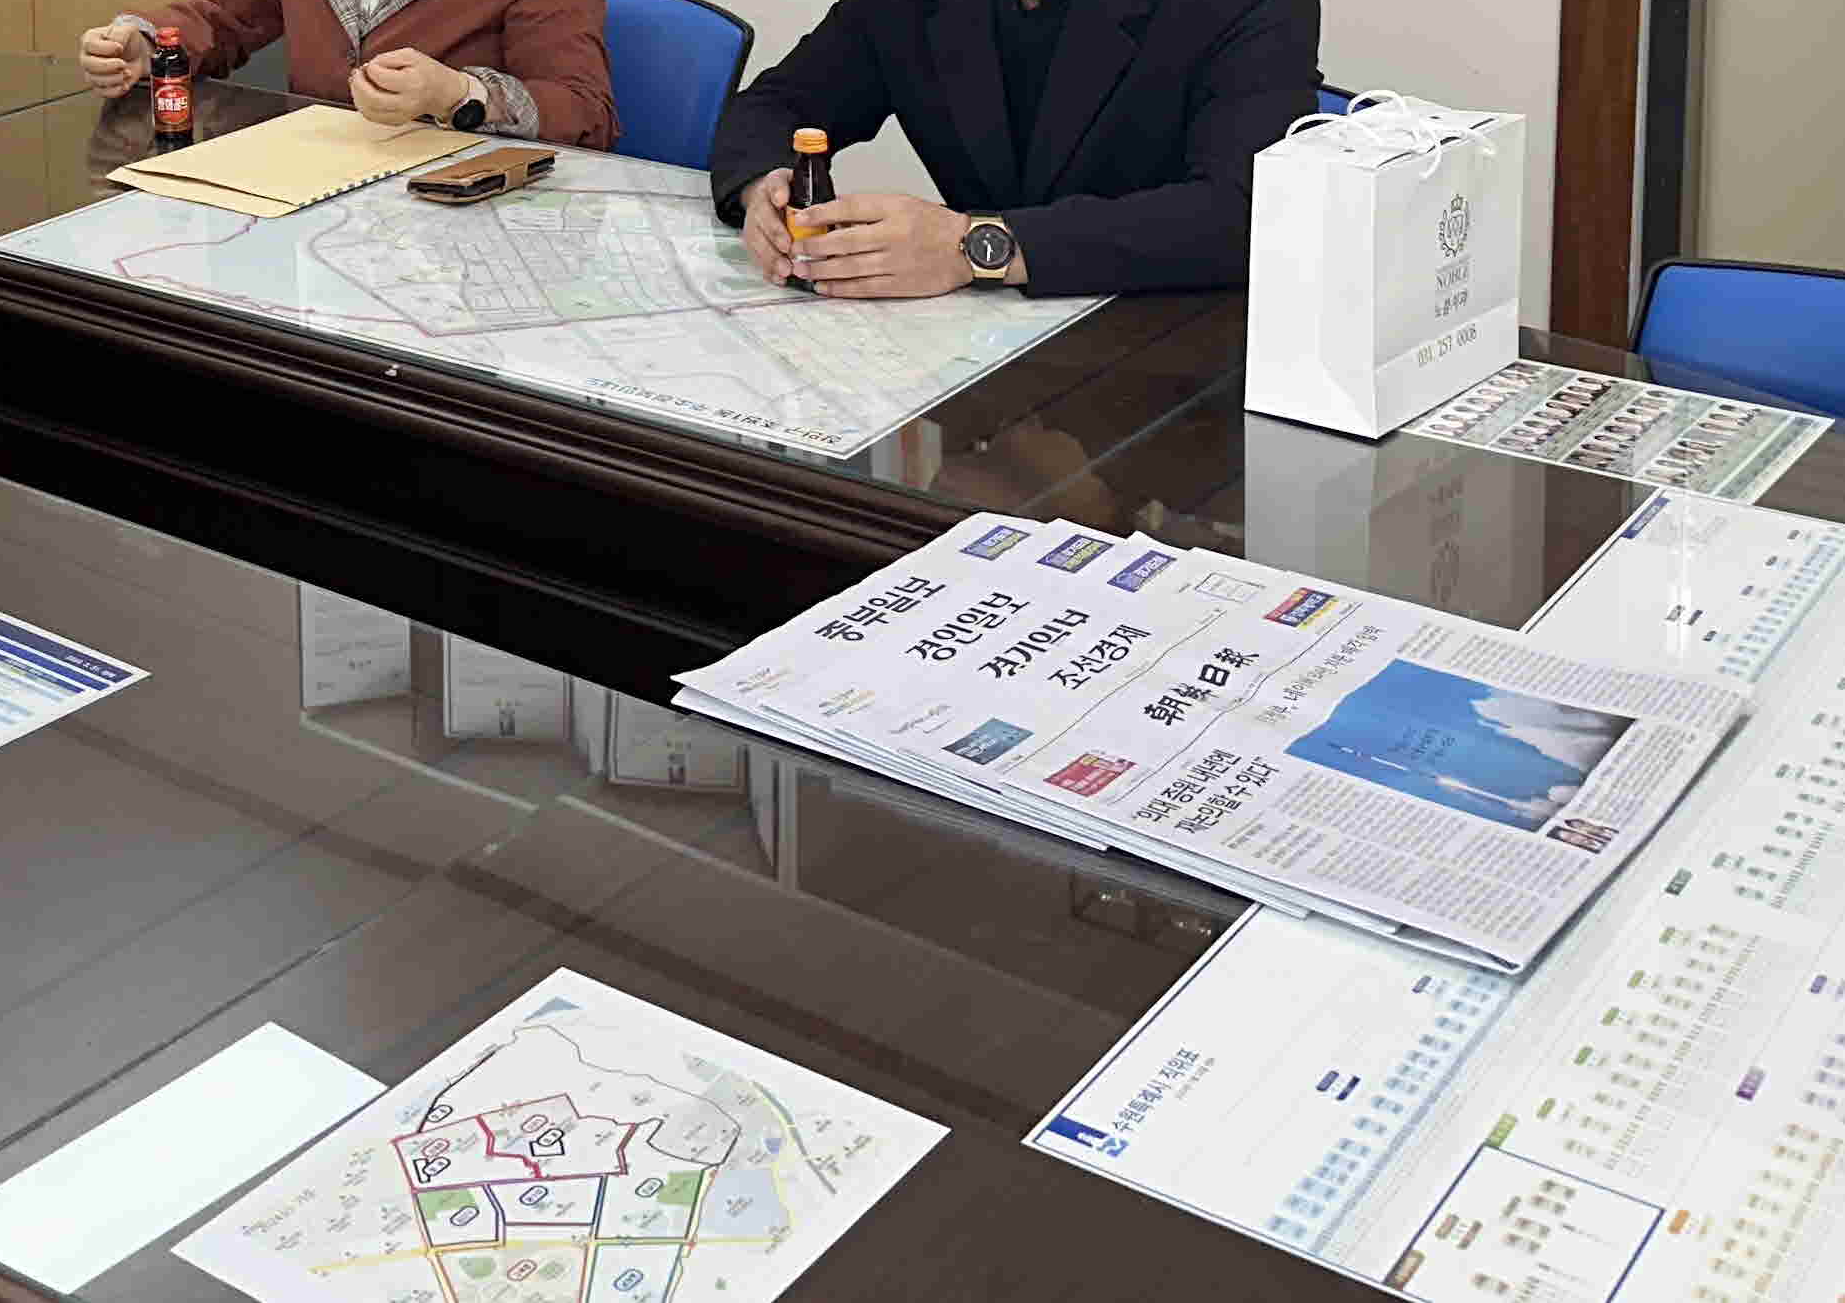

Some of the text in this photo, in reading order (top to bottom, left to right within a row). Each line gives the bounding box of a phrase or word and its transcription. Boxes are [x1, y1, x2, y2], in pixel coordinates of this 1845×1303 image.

[814, 576, 947, 642] 중부일보
[905, 591, 1030, 662] 경인일보
[978, 608, 1091, 679] 경기일보
[1047, 624, 1152, 690] 조선경제
[1142, 647, 1261, 726] 朝鮮日報
[1161, 778, 1206, 803] 증원
[1187, 749, 1243, 782] 내년엔
[1225, 785, 1253, 798] 수
